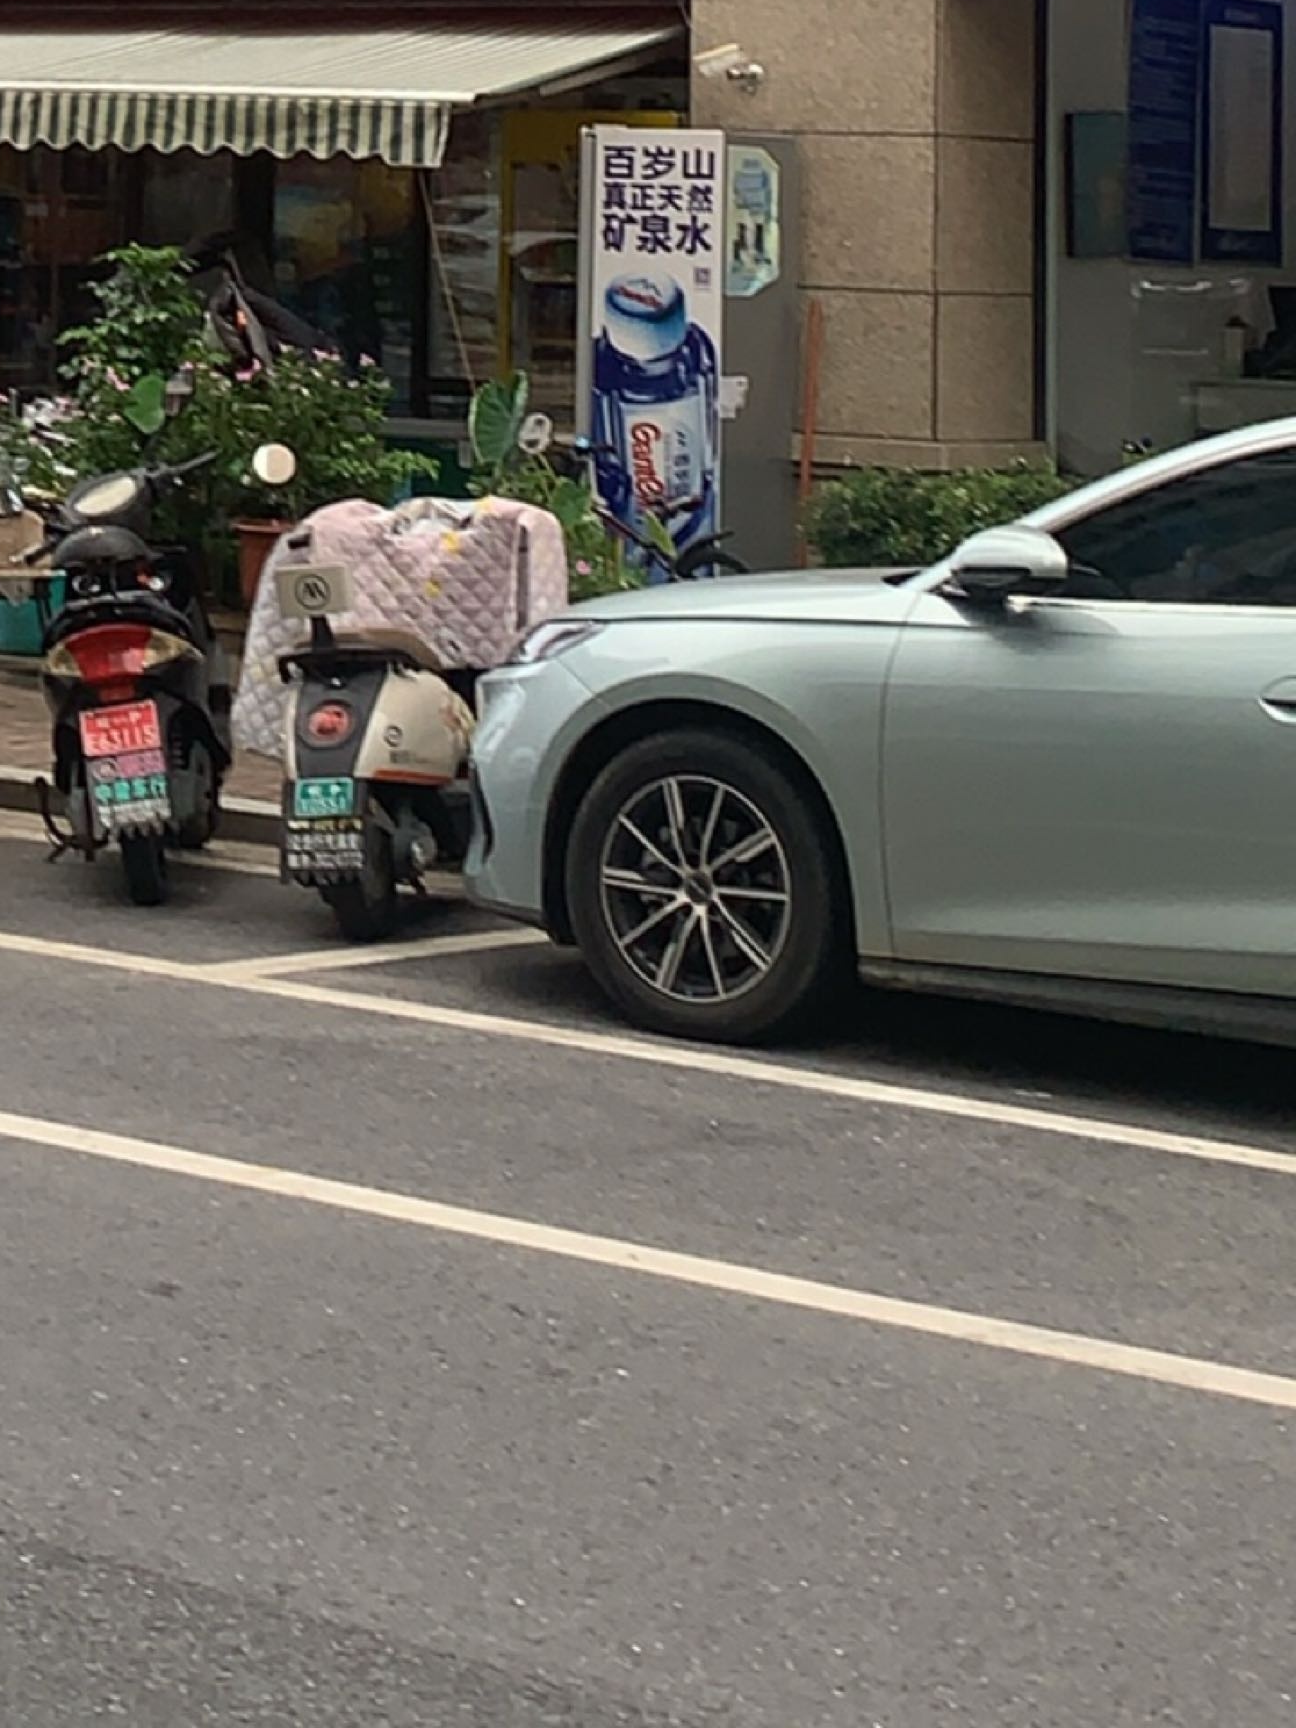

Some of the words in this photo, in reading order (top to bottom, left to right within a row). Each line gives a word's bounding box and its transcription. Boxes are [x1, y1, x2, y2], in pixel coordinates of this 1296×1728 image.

[603, 144, 716, 181] 百岁山
[602, 181, 713, 213] 真正天然
[602, 212, 713, 255] 矿泉水
